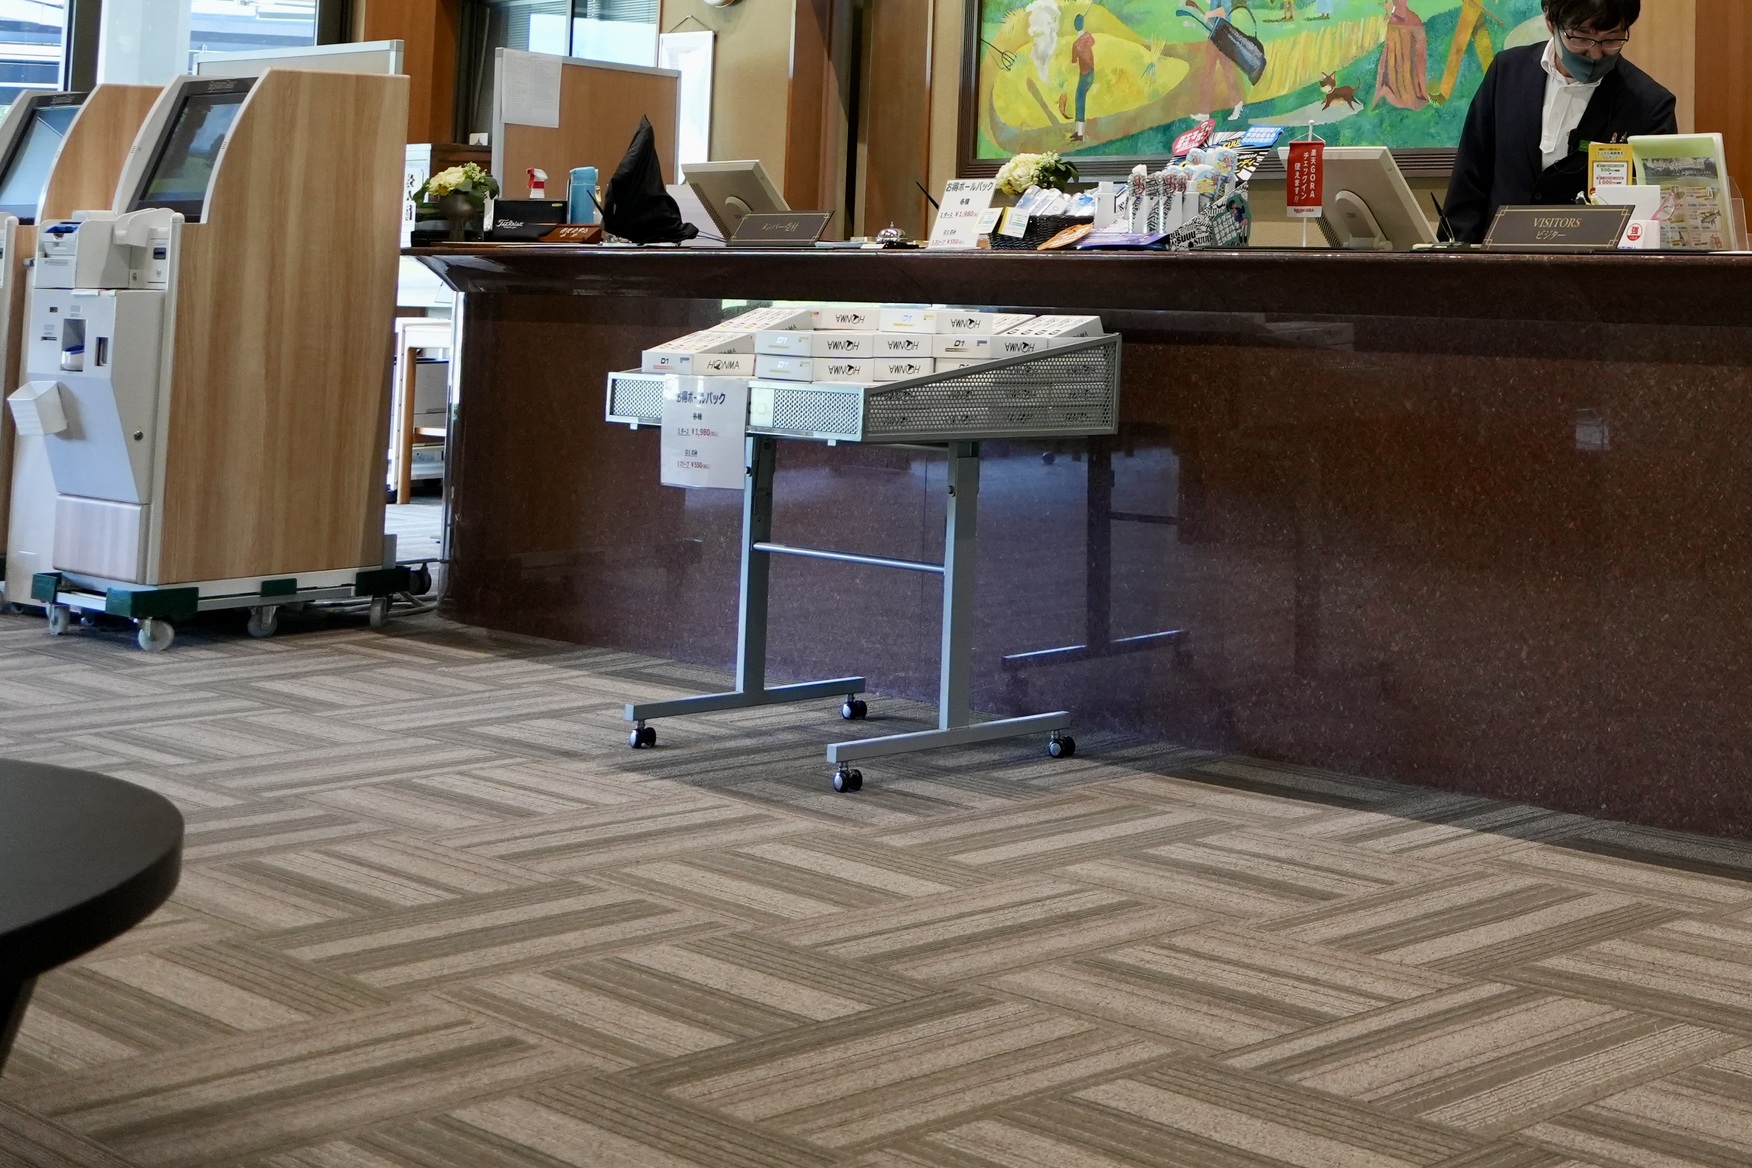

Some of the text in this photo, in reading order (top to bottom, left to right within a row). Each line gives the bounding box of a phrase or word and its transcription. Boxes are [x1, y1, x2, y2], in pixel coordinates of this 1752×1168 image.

[1533, 217, 1582, 228] VISITORS
[1535, 230, 1566, 240] ビジター
[776, 336, 787, 344] D1
[827, 339, 860, 352] HONMA
[887, 340, 920, 351] HONMA
[1004, 341, 1035, 353] HONMA
[706, 360, 740, 371] HONMA
[777, 360, 789, 368] D1
[888, 363, 921, 375] HONMA
[828, 364, 861, 376] HONMA
